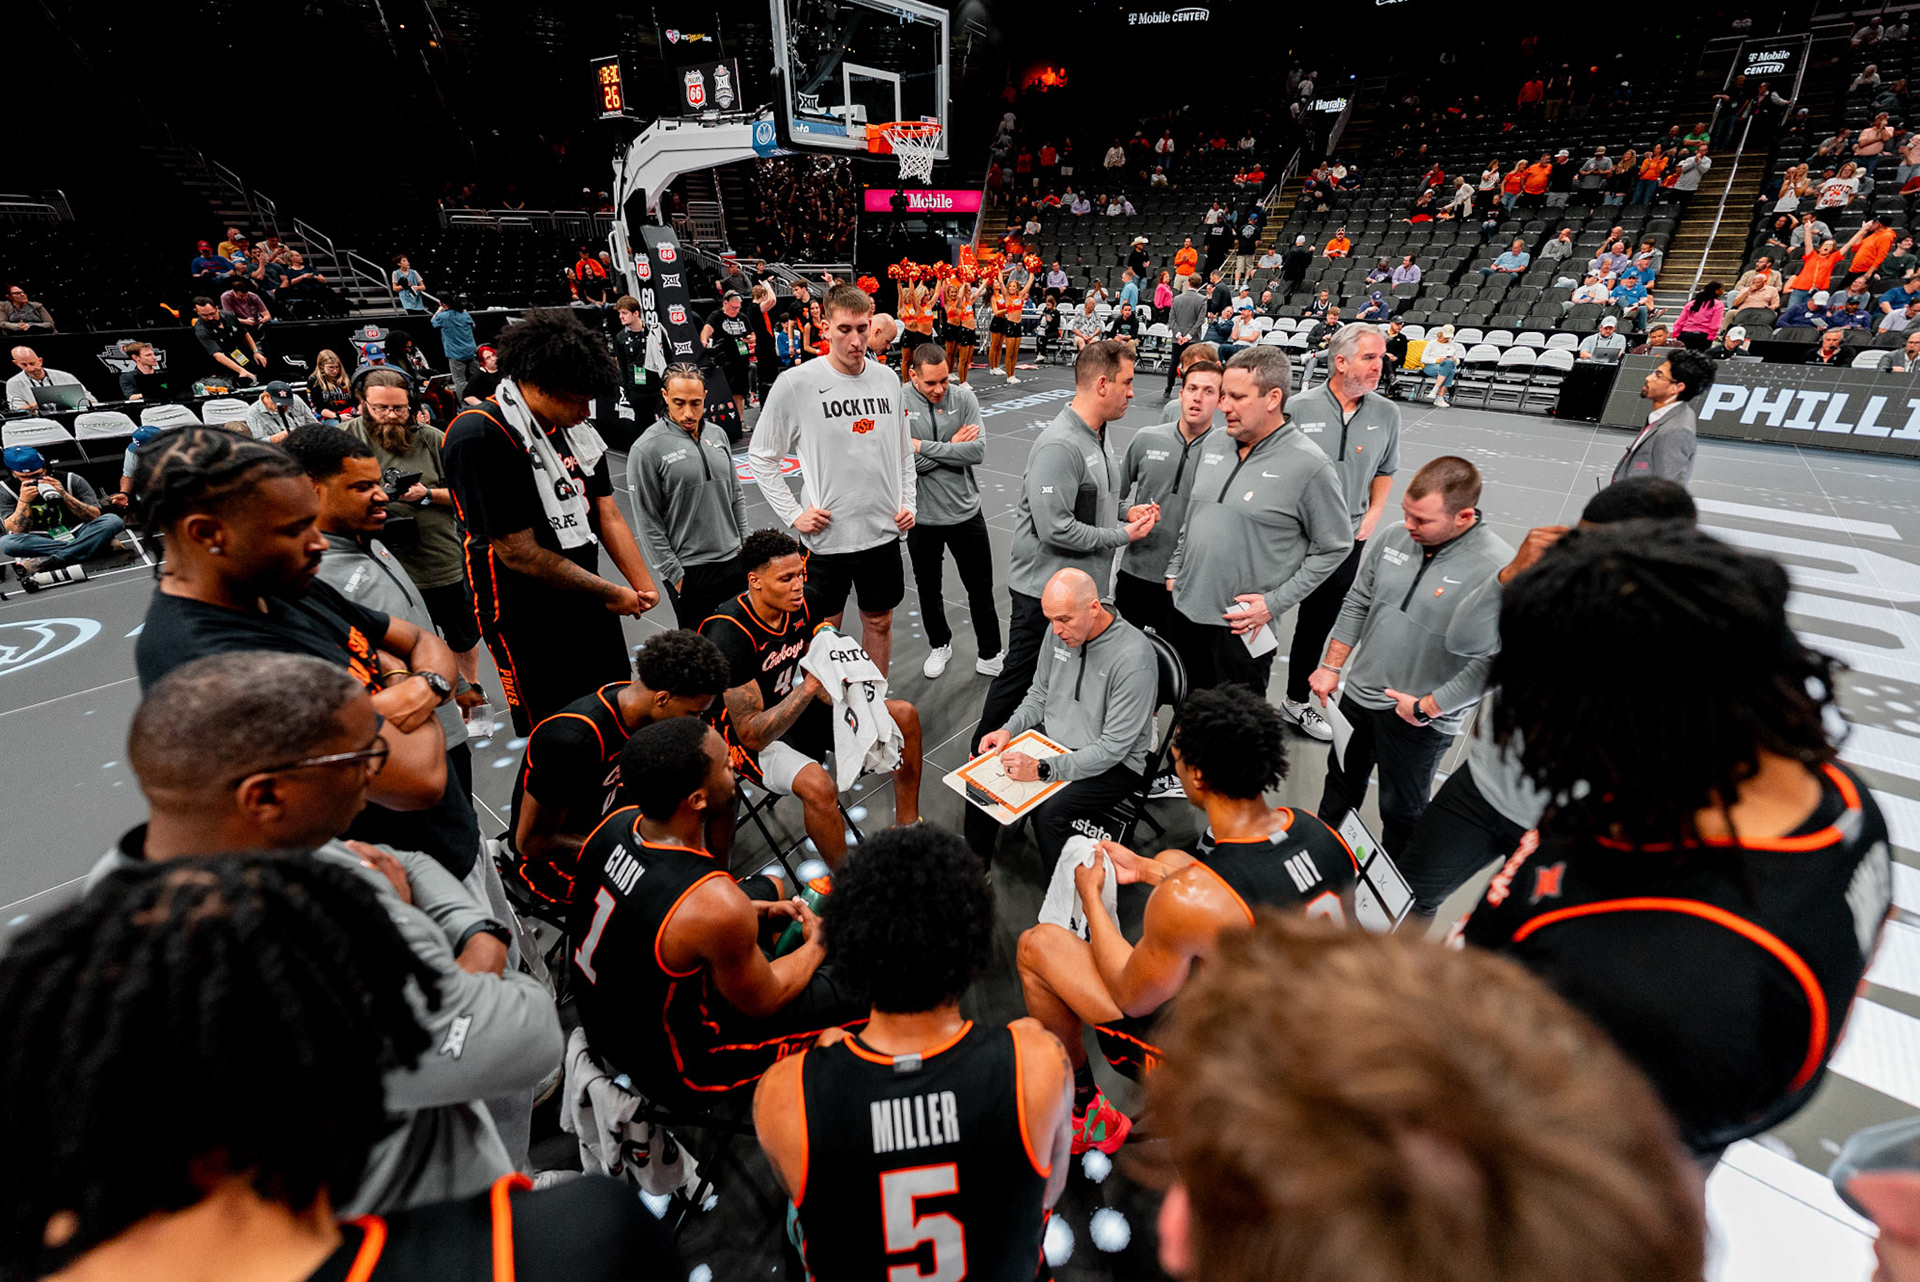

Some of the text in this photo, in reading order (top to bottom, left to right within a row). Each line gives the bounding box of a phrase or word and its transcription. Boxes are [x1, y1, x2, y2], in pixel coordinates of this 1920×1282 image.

[1138, 11, 1171, 25] Mobile
[1172, 12, 1206, 23] CENTER
[1757, 50, 1790, 62] Mobile
[1744, 65, 1781, 75] CENTER
[604, 86, 620, 108] 26
[690, 86, 702, 101] 66
[909, 193, 953, 209] Mobile
[662, 250, 673, 259] 66
[639, 264, 648, 275] 66
[641, 288, 655, 311] GO
[672, 312, 683, 321] 66
[822, 399, 862, 419] LOCK
[863, 398, 876, 415] IT
[852, 418, 875, 434] OSU
[500, 667, 520, 706] POKES
[774, 665, 793, 696] 4
[604, 843, 646, 896] CLARY
[1283, 849, 1323, 893] ROY
[574, 885, 617, 986] 1
[869, 1090, 961, 1155] MILLER
[879, 1162, 969, 1282] 5
